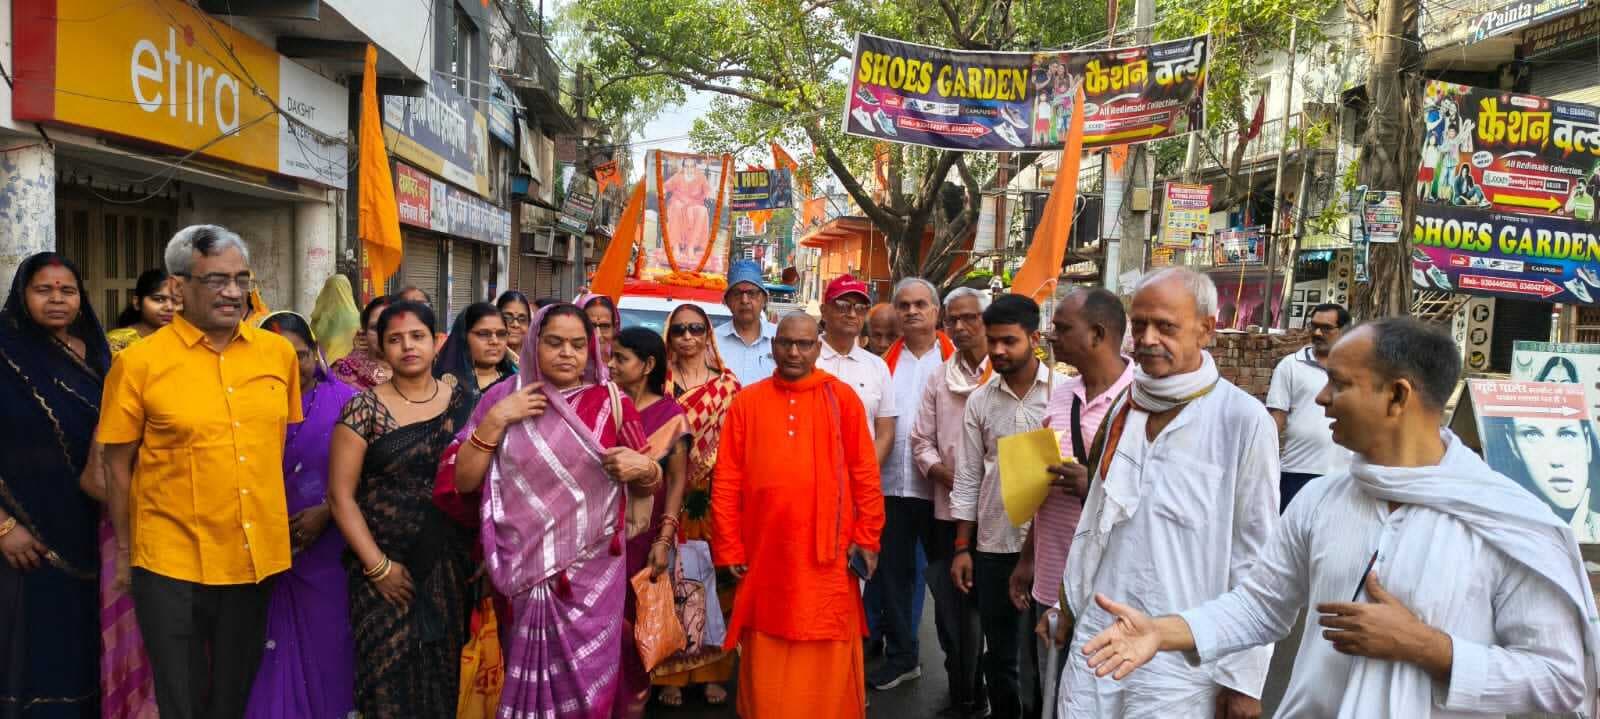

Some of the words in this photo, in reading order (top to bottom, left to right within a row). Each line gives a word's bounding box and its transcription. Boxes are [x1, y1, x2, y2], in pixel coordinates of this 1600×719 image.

[1486, 2, 1532, 30] Painta
[131, 25, 240, 137] etira
[858, 50, 933, 95] SHOES
[936, 64, 1029, 101] GARDEN
[287, 96, 316, 121] DAKSHIT
[1503, 159, 1515, 168] All
[1412, 215, 1493, 252] SHOES
[1498, 225, 1600, 263] GARDEN
